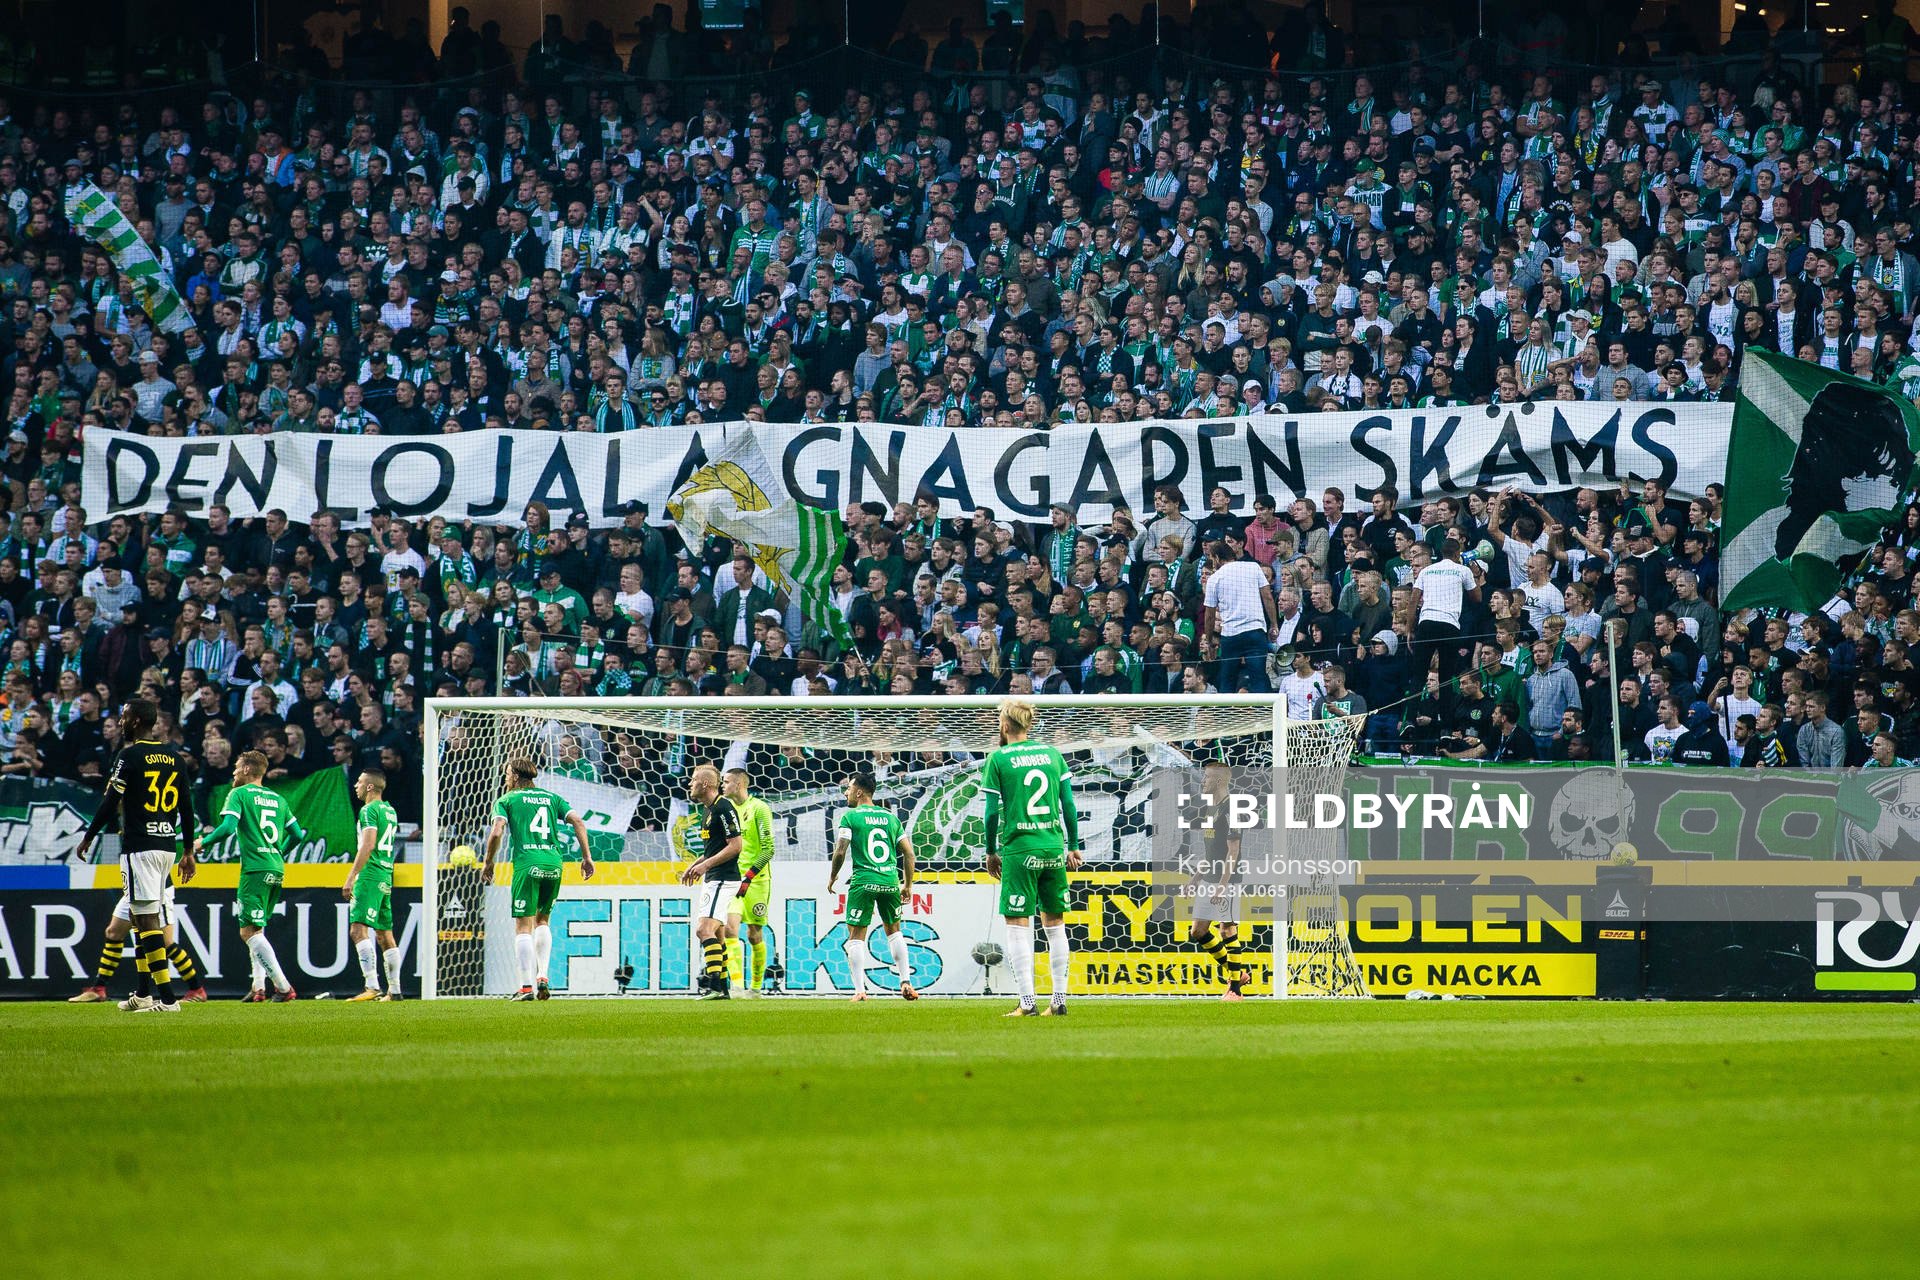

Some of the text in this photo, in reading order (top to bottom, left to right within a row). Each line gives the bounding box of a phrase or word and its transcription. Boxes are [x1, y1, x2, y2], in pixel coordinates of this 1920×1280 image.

[106, 401, 1677, 521] DEN LOJALA GNAGAREN SKÄMS
[145, 754, 175, 766] GOITOM
[1010, 754, 1051, 768] SANDBERG
[144, 771, 179, 813] 36
[523, 796, 551, 806] PAULSEN
[1023, 769, 1051, 816] 2
[146, 821, 175, 833] SVEA
[259, 809, 279, 844] 5
[529, 807, 551, 840] 4
[865, 816, 889, 825] HAMAD
[867, 828, 890, 863] 6
[1605, 909, 1630, 918] SELECT
[1427, 964, 1542, 986] NACKA
